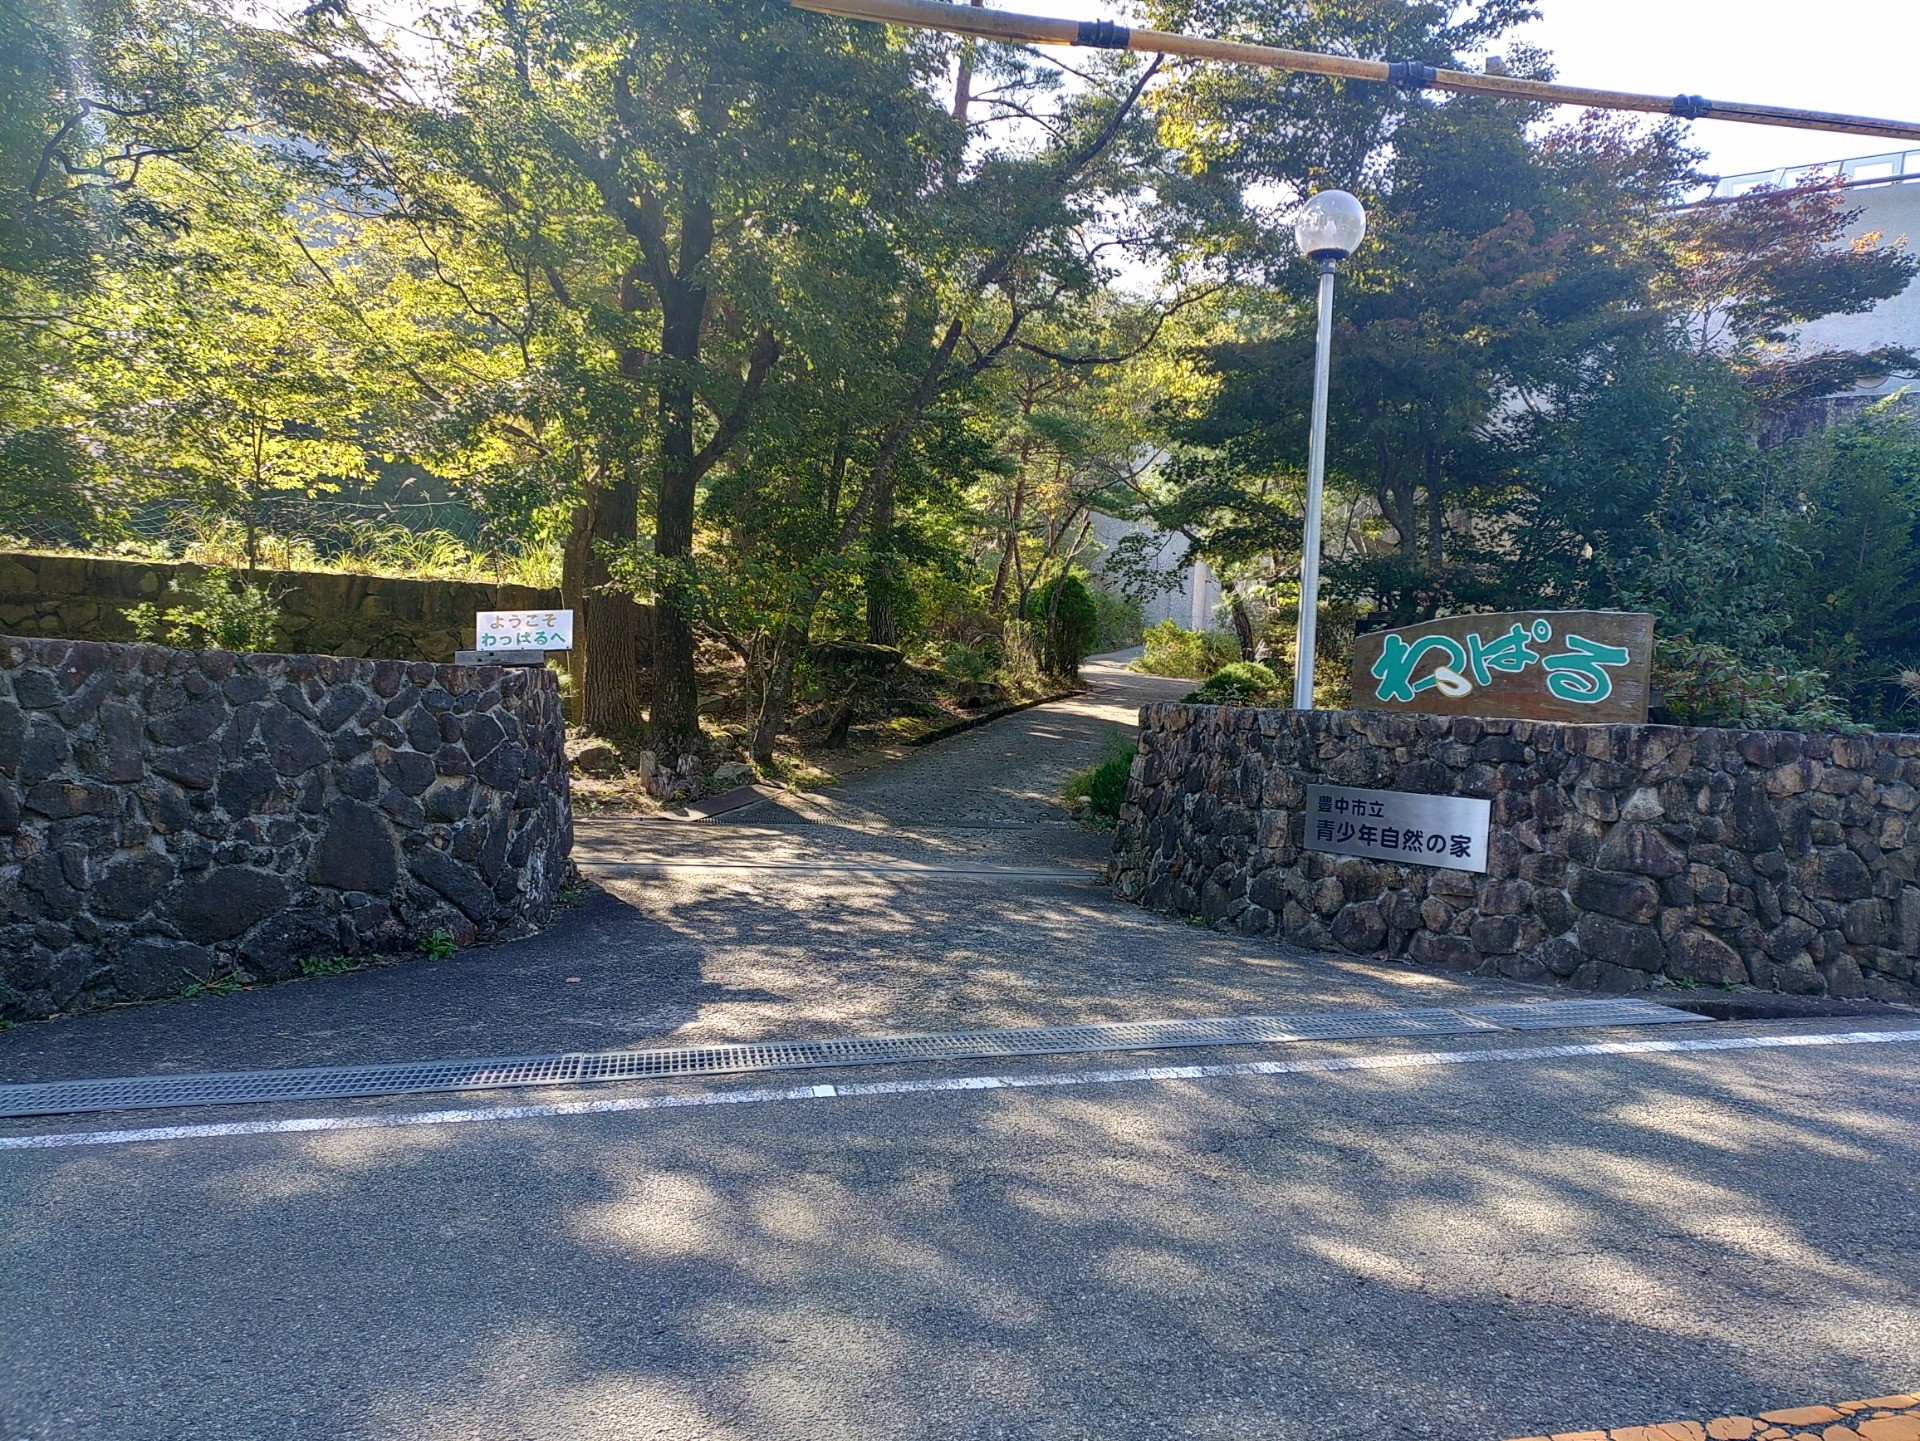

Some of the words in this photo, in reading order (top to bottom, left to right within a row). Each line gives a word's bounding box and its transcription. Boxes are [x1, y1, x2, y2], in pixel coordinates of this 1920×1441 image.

[490, 614, 557, 629] ようこそ
[481, 631, 566, 646] わっぱるへ
[1317, 795, 1385, 818] 豊中市立
[1316, 819, 1472, 858] 青少年自然の家
